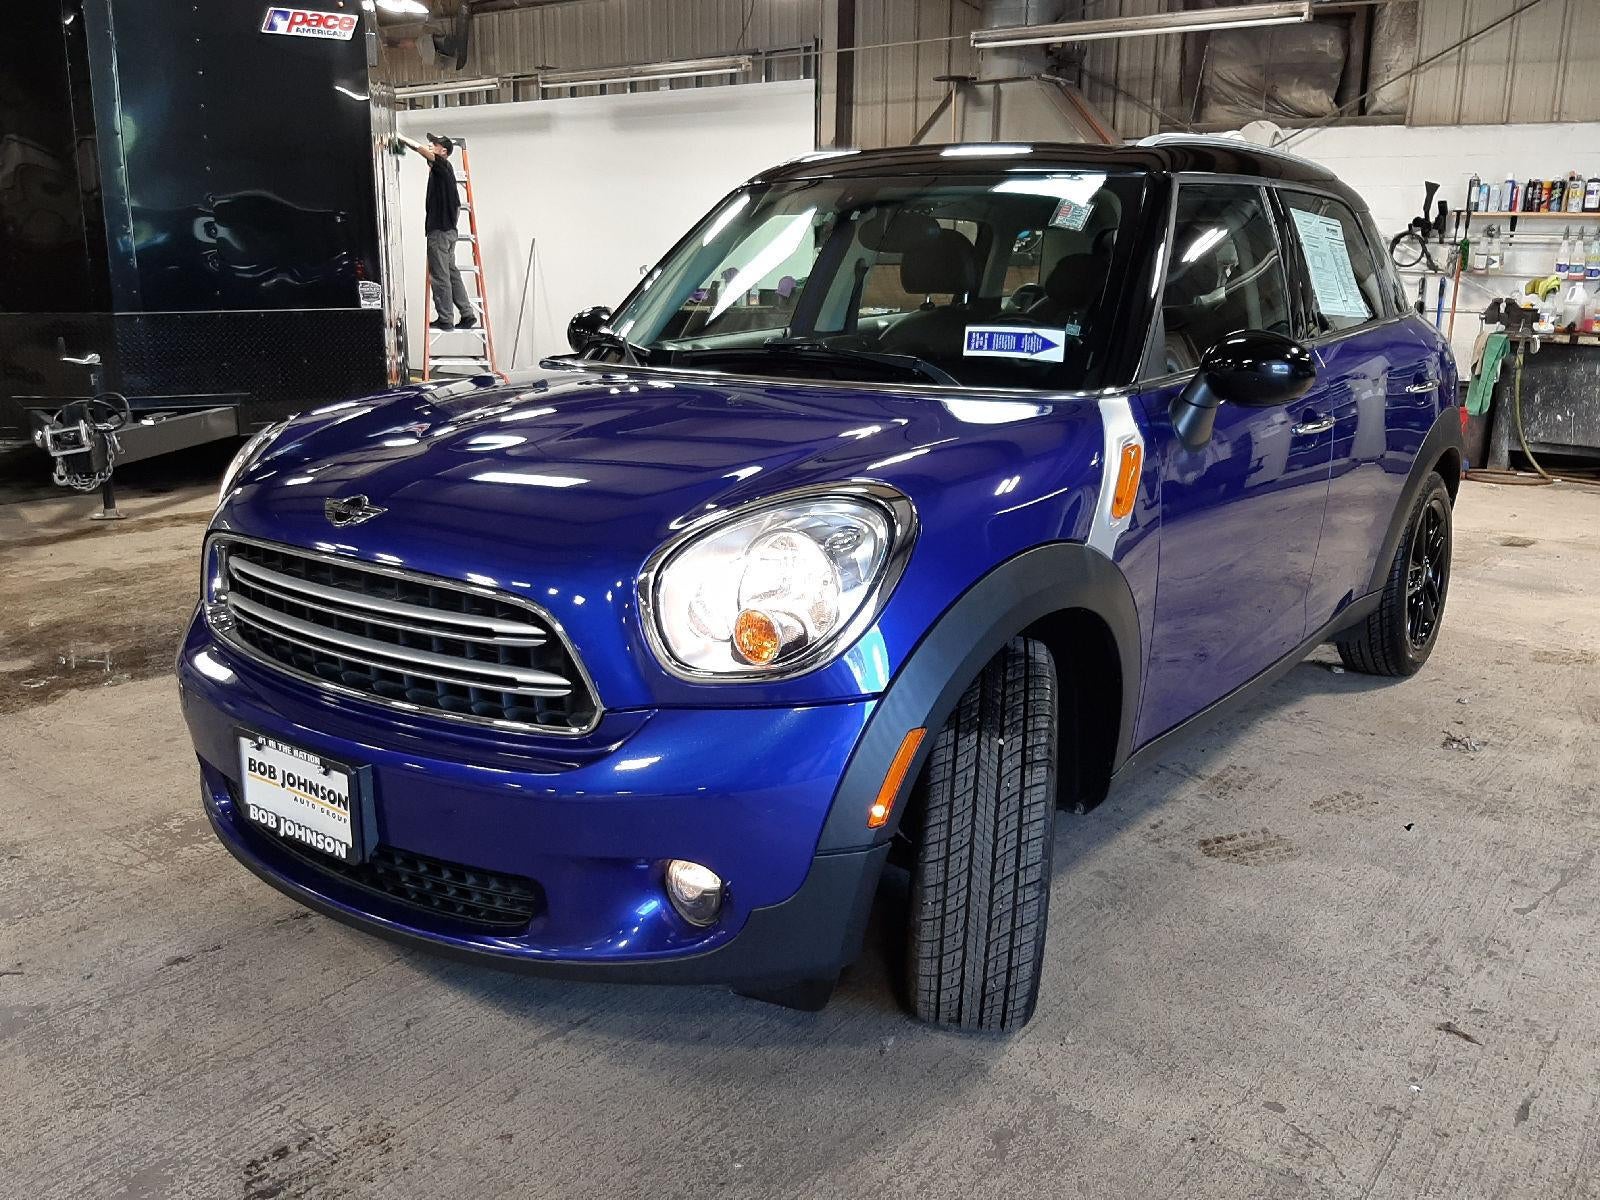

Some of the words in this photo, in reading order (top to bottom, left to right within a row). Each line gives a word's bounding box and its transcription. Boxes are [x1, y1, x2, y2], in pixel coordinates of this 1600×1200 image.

[286, 11, 355, 33] pace
[277, 743, 292, 755] THE
[293, 749, 320, 765] NATION
[248, 757, 277, 780] BOB
[281, 769, 348, 811] JOHNSON
[293, 796, 316, 810] AUTO
[320, 807, 348, 824] GROUP
[249, 805, 277, 828] BOB
[279, 818, 347, 859] JOHNSON
